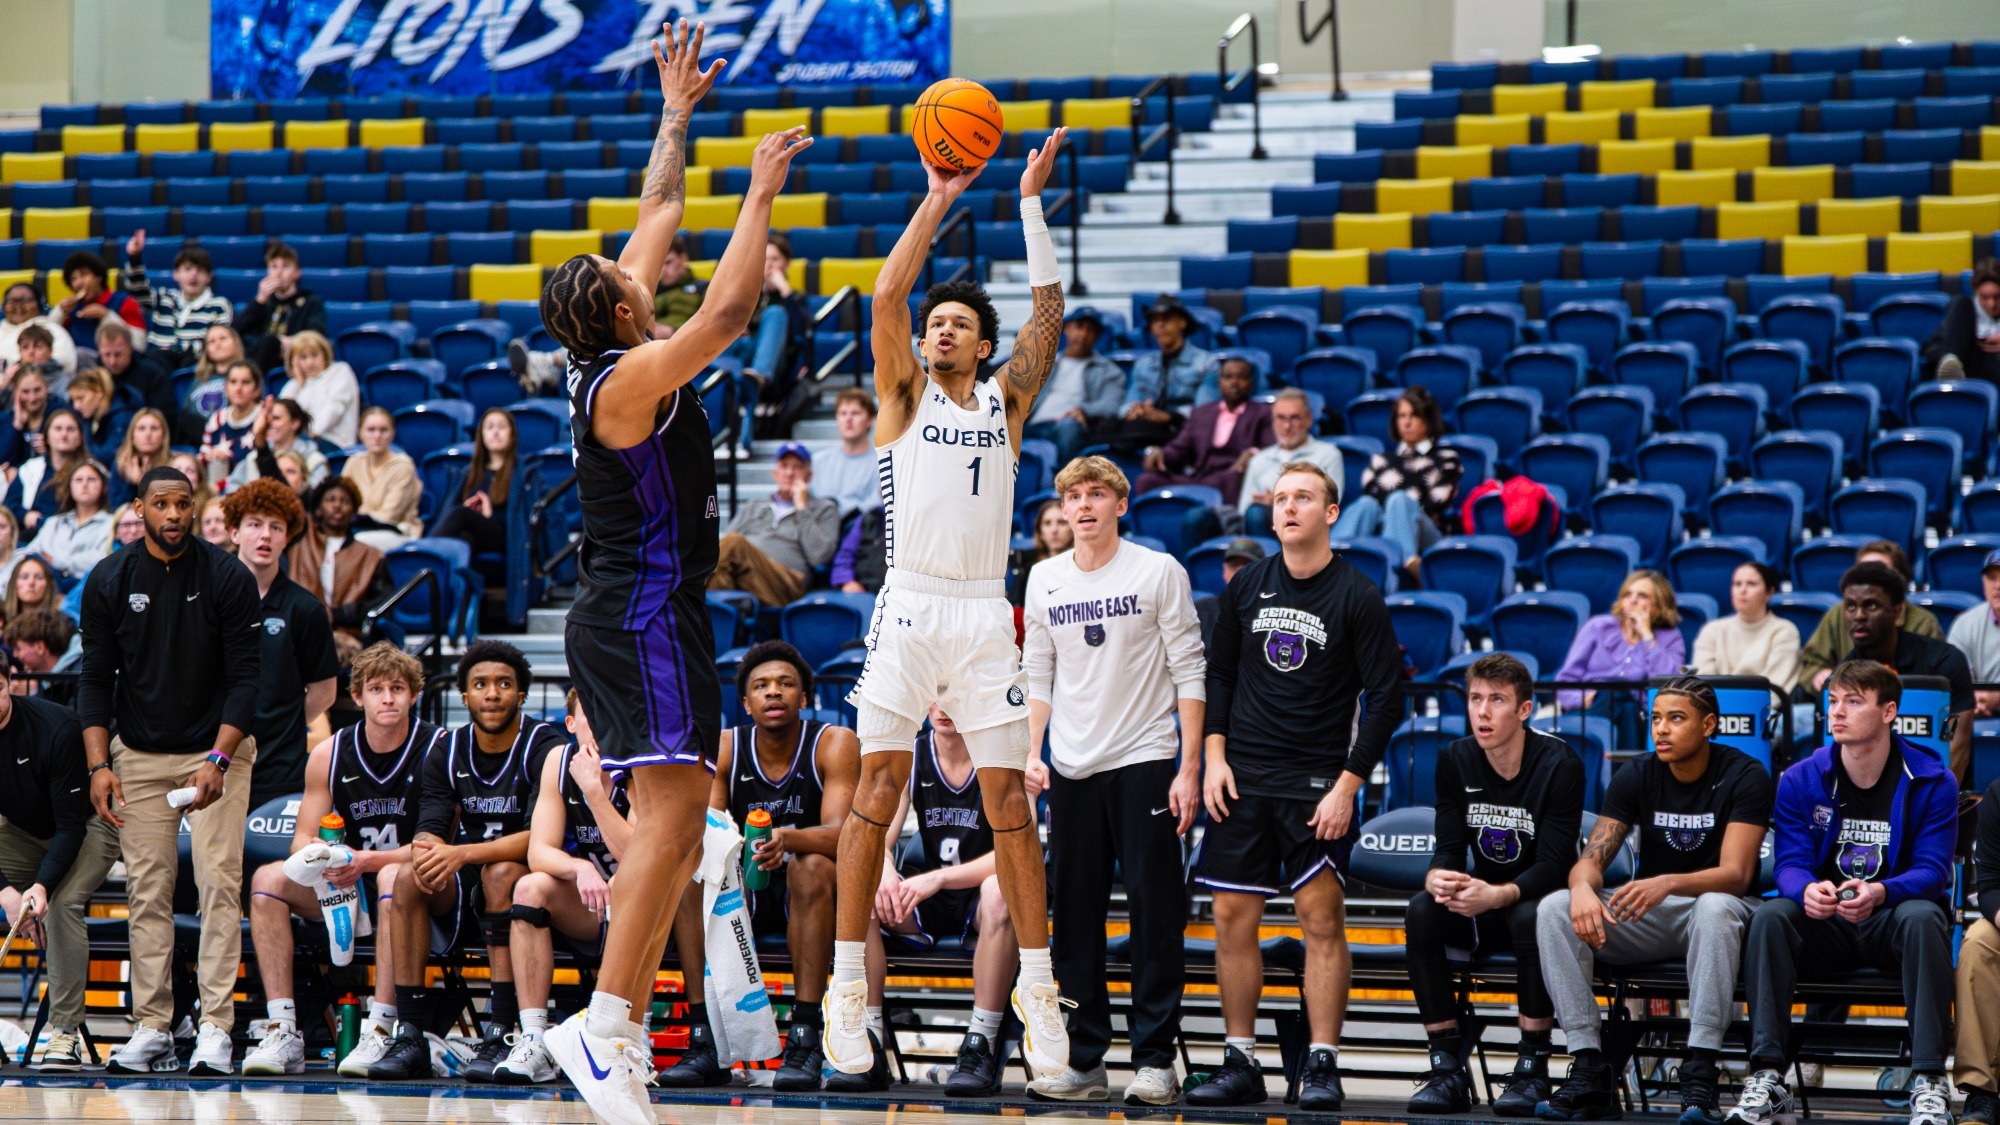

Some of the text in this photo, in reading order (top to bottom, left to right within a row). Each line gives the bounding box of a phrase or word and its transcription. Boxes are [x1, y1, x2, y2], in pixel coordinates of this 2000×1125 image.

[296, 0, 585, 91] LIONS
[776, 60, 919, 83] STUDENT SECTION
[922, 424, 1006, 448] QUEENS
[966, 456, 983, 497] 1
[1048, 594, 1143, 627] NOTHING EASY.
[1258, 607, 1325, 631] CENTRAL
[1252, 618, 1328, 644] ARKANSAS
[924, 807, 980, 830] CENTRAL
[1653, 811, 1715, 829] BEARS
[939, 837, 962, 869] 9
[730, 916, 760, 985] POWERADE
